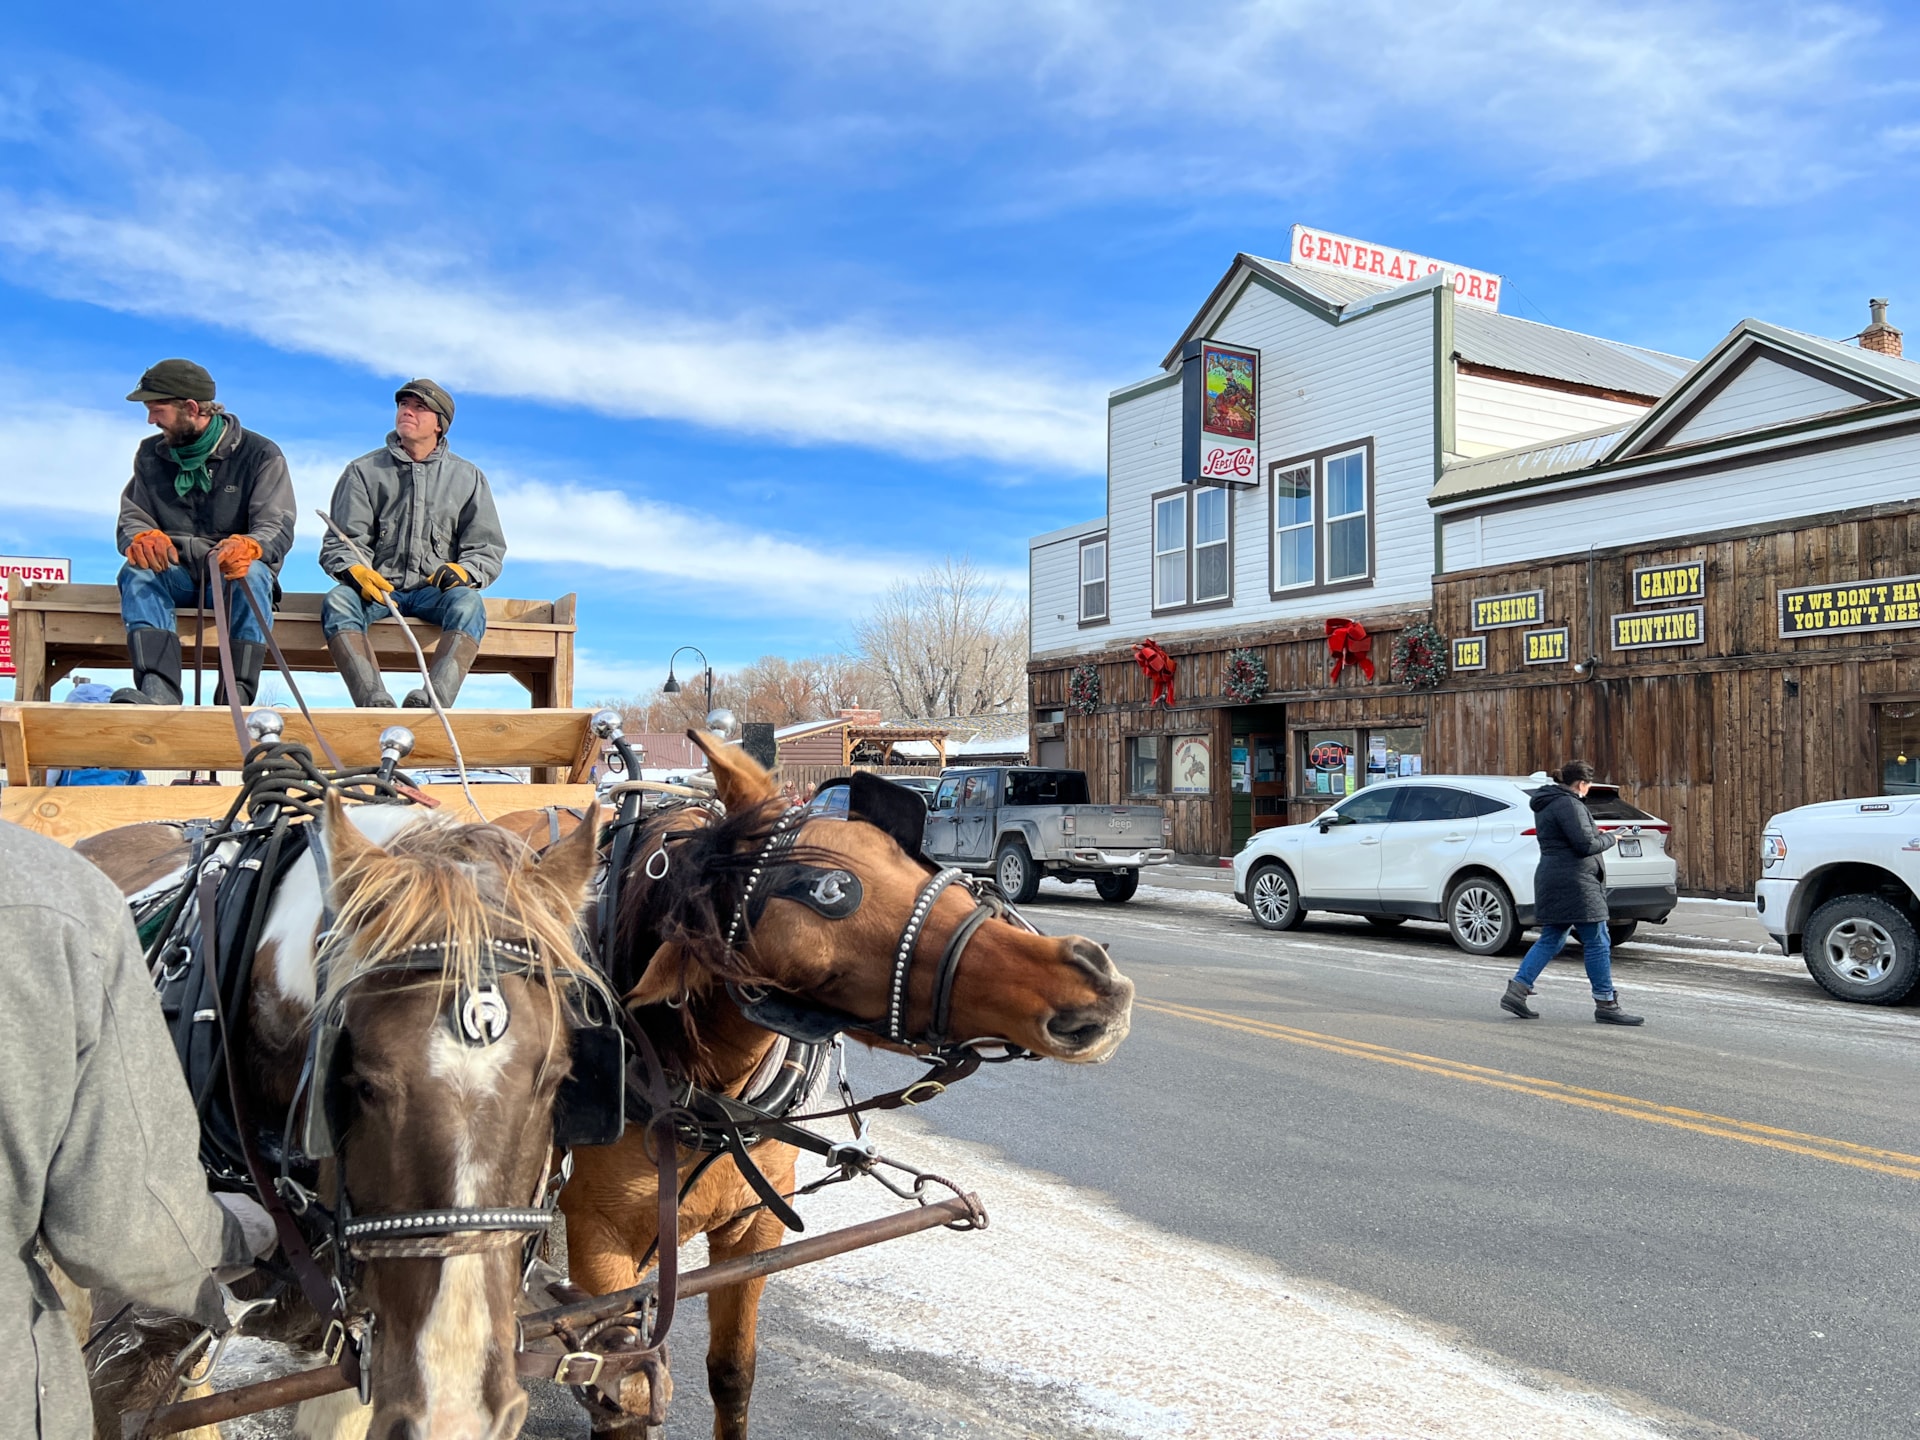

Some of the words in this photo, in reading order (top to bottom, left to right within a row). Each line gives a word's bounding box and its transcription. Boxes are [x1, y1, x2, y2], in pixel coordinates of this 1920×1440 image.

[1299, 233, 1420, 281] GENERAL
[1427, 263, 1498, 302] SORE
[1641, 567, 1699, 598] CANDY
[1478, 596, 1536, 626] FISHING
[1788, 594, 1804, 612] IF
[1808, 592, 1833, 610] WE
[1837, 586, 1887, 607] DON'T
[1618, 613, 1696, 644] HUNTING
[1794, 611, 1824, 629] YOU
[1829, 606, 1879, 626] DON'T
[1884, 601, 1920, 622] NEE
[1458, 642, 1480, 666] ICE
[1529, 633, 1563, 660] BAIT
[1310, 746, 1348, 765] OPEN
[1109, 819, 1132, 829] Jeep
